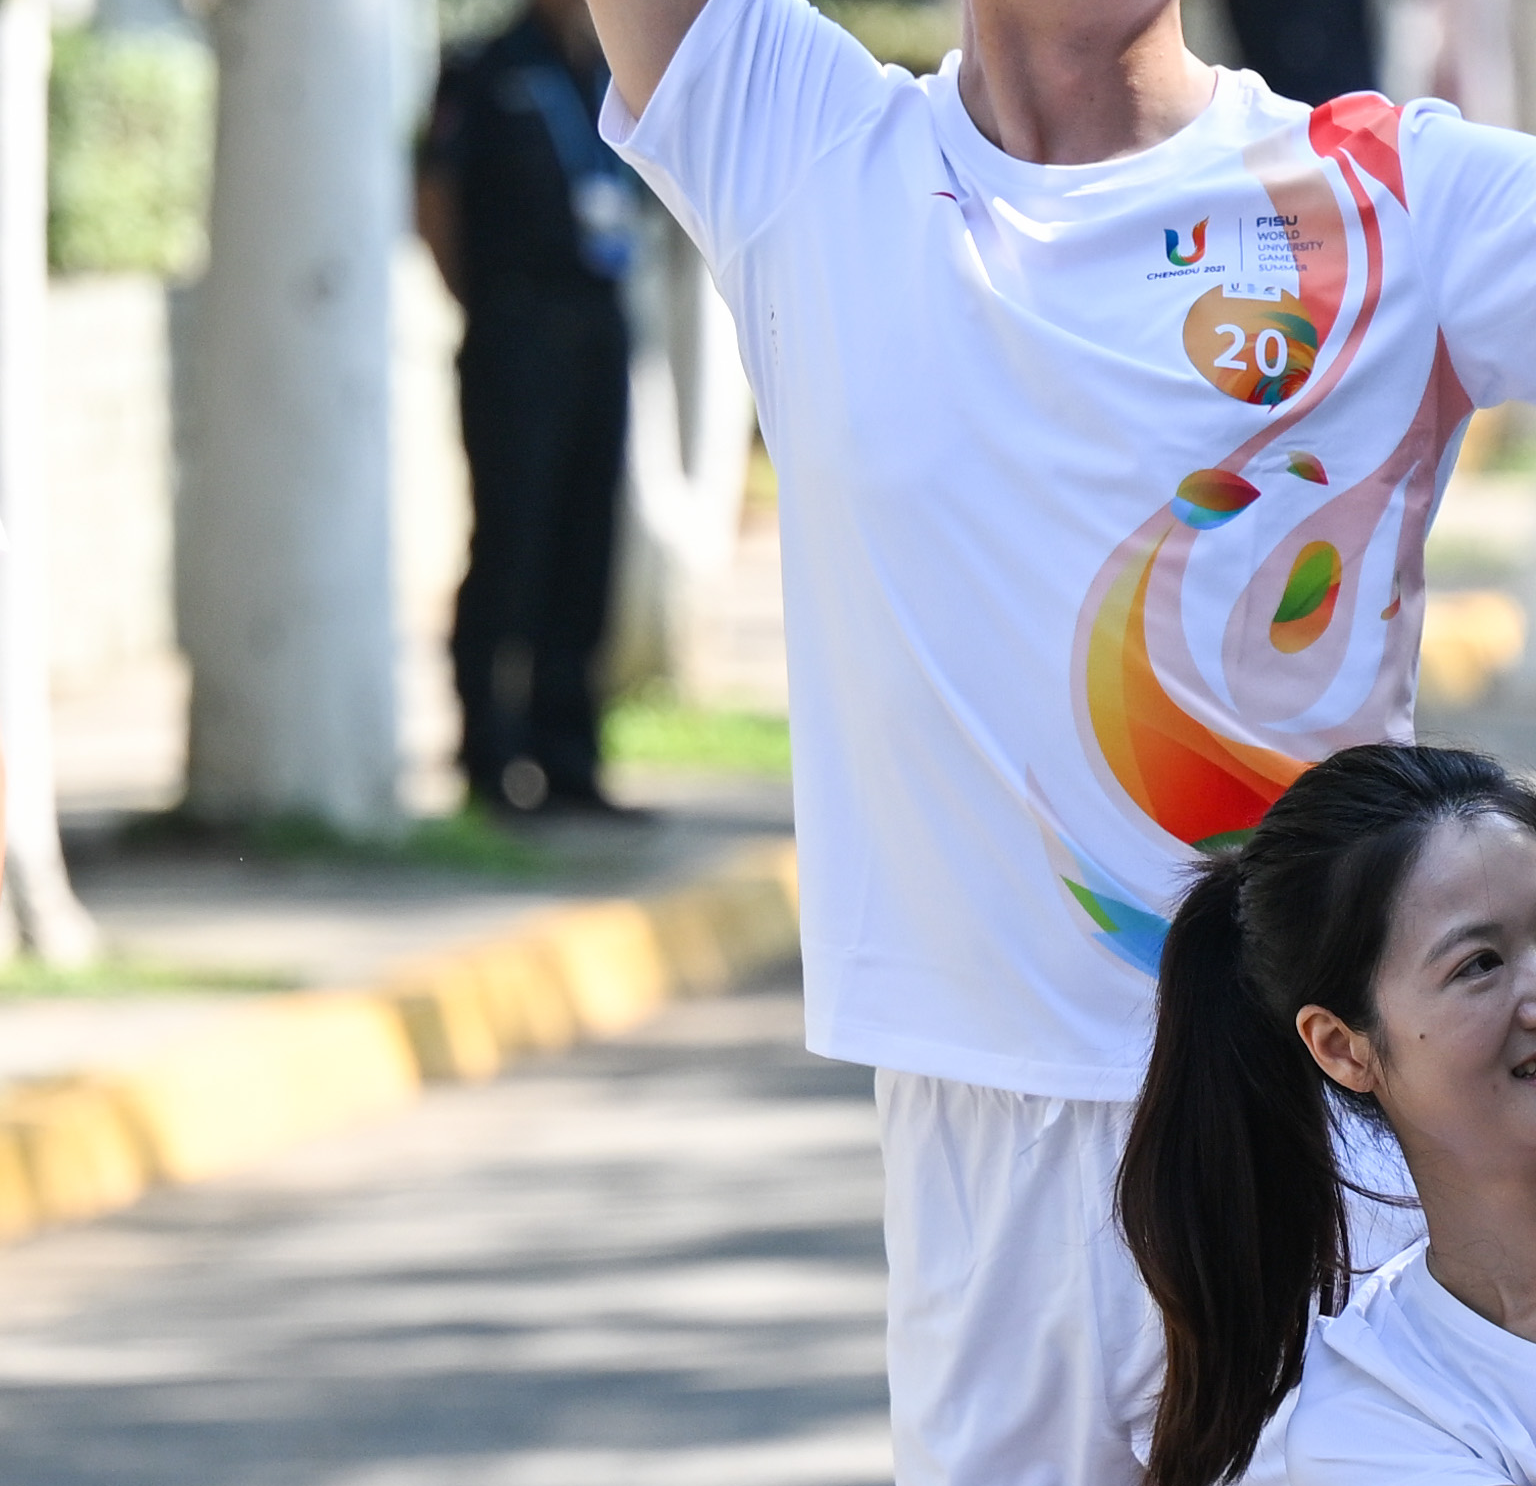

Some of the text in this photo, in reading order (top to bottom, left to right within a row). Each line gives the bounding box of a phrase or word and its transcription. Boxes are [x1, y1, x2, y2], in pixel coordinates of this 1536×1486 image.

[1256, 215, 1298, 228] FISU
[1257, 230, 1300, 241] WORLD
[1258, 241, 1324, 252] UNIVERSITY
[1258, 253, 1298, 263] GAMES
[1146, 265, 1226, 281] CHENGDU 2021
[1258, 263, 1308, 272] SUMMER
[1213, 323, 1289, 377] 20
